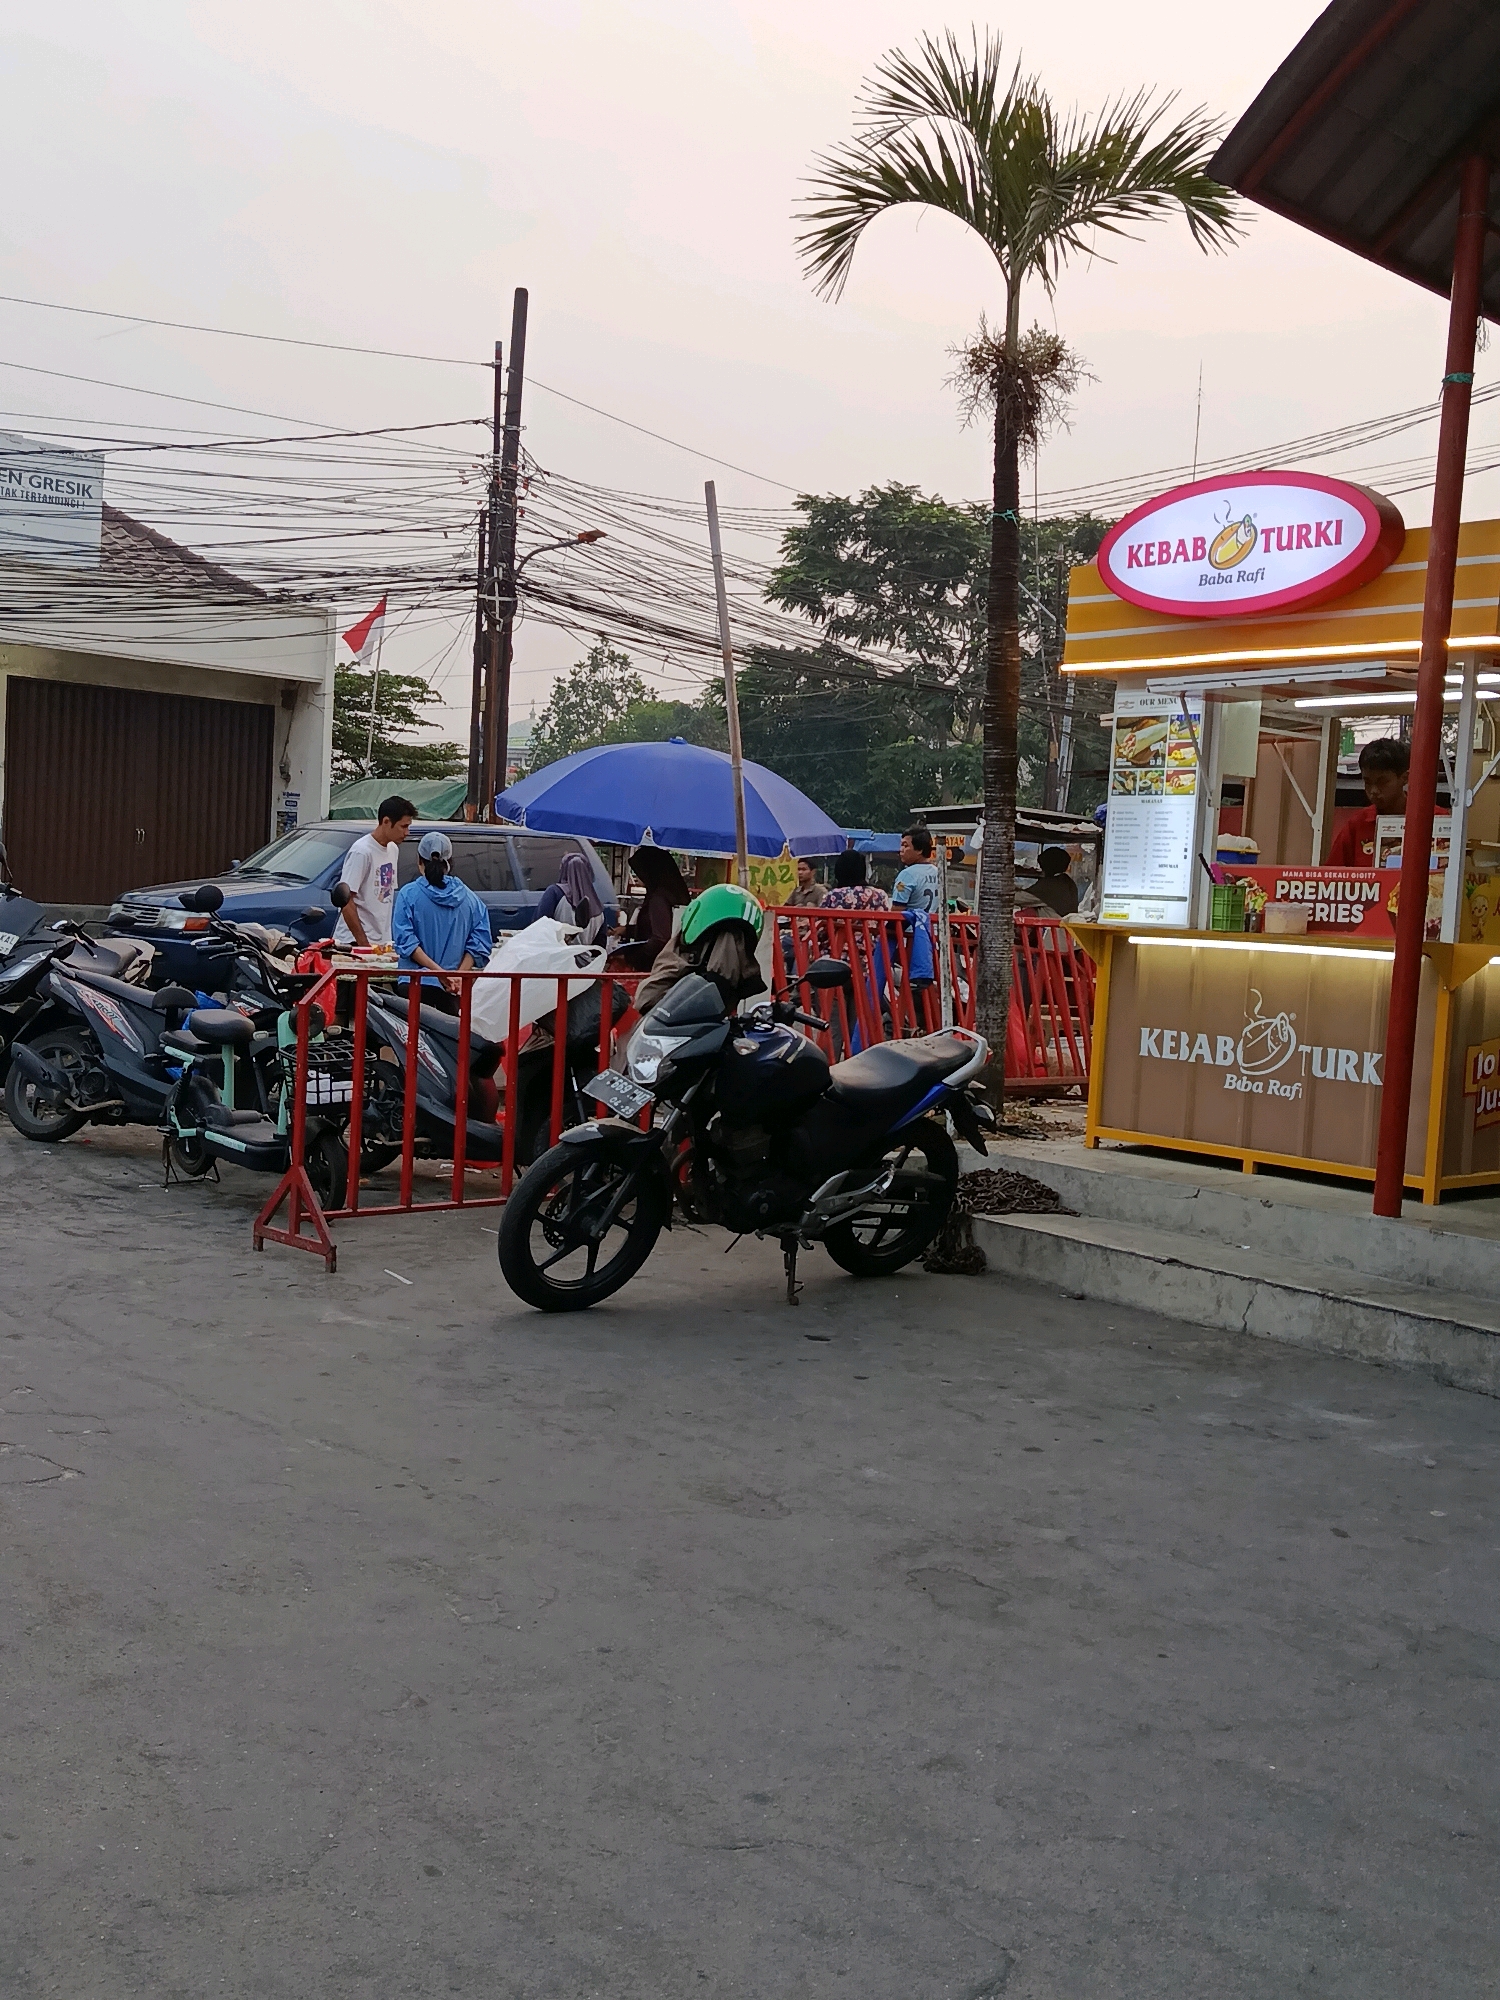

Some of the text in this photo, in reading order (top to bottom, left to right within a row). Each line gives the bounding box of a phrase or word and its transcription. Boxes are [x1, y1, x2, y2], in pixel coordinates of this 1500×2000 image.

[28, 474, 93, 499] GRESIK
[1127, 519, 1343, 569] KEBAB TURKI
[1198, 567, 1266, 587] Baba Rafi
[1324, 871, 1349, 879] SEKALI
[1275, 880, 1380, 902] PREMIUM
[1301, 902, 1365, 924] ERIES
[1139, 1027, 1384, 1086] KEBAB TURK
[1266, 1079, 1303, 1101] Rafi
